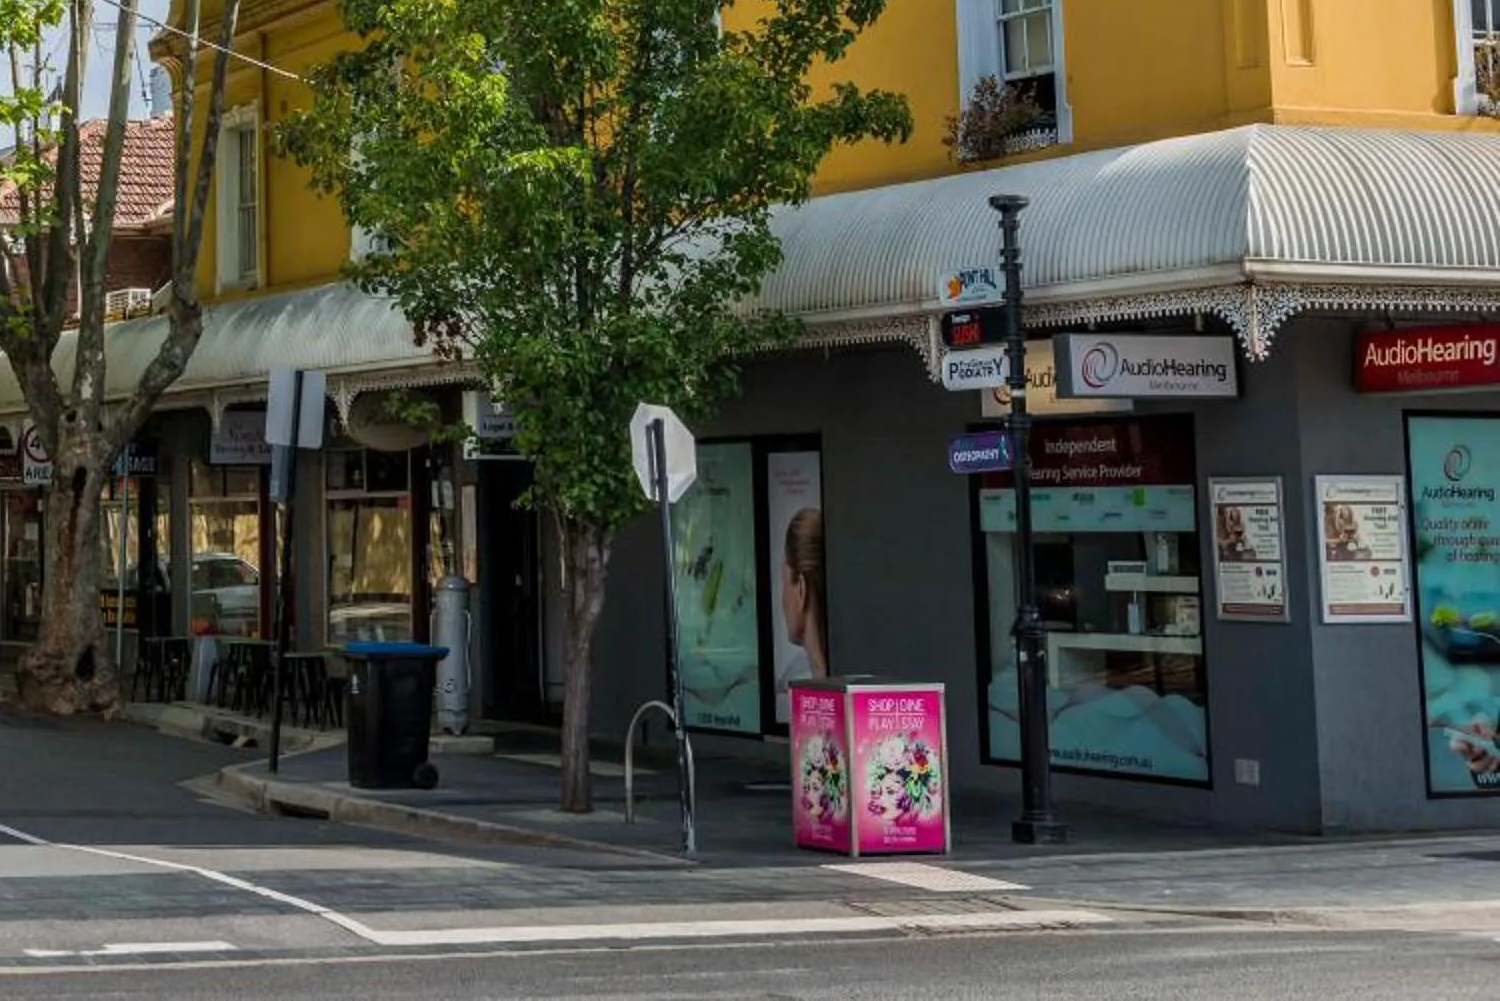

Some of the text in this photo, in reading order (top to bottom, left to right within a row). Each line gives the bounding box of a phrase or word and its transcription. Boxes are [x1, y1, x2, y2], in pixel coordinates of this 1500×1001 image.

[1364, 334, 1497, 368] AudioHearing
[1119, 358, 1227, 382] AudioHearing
[1062, 463, 1097, 480] Service
[1100, 462, 1142, 480] Provider
[1422, 486, 1495, 501] AudioHearing
[868, 698, 925, 712] SHOP DINE
[869, 716, 925, 730] PLAY STAY
